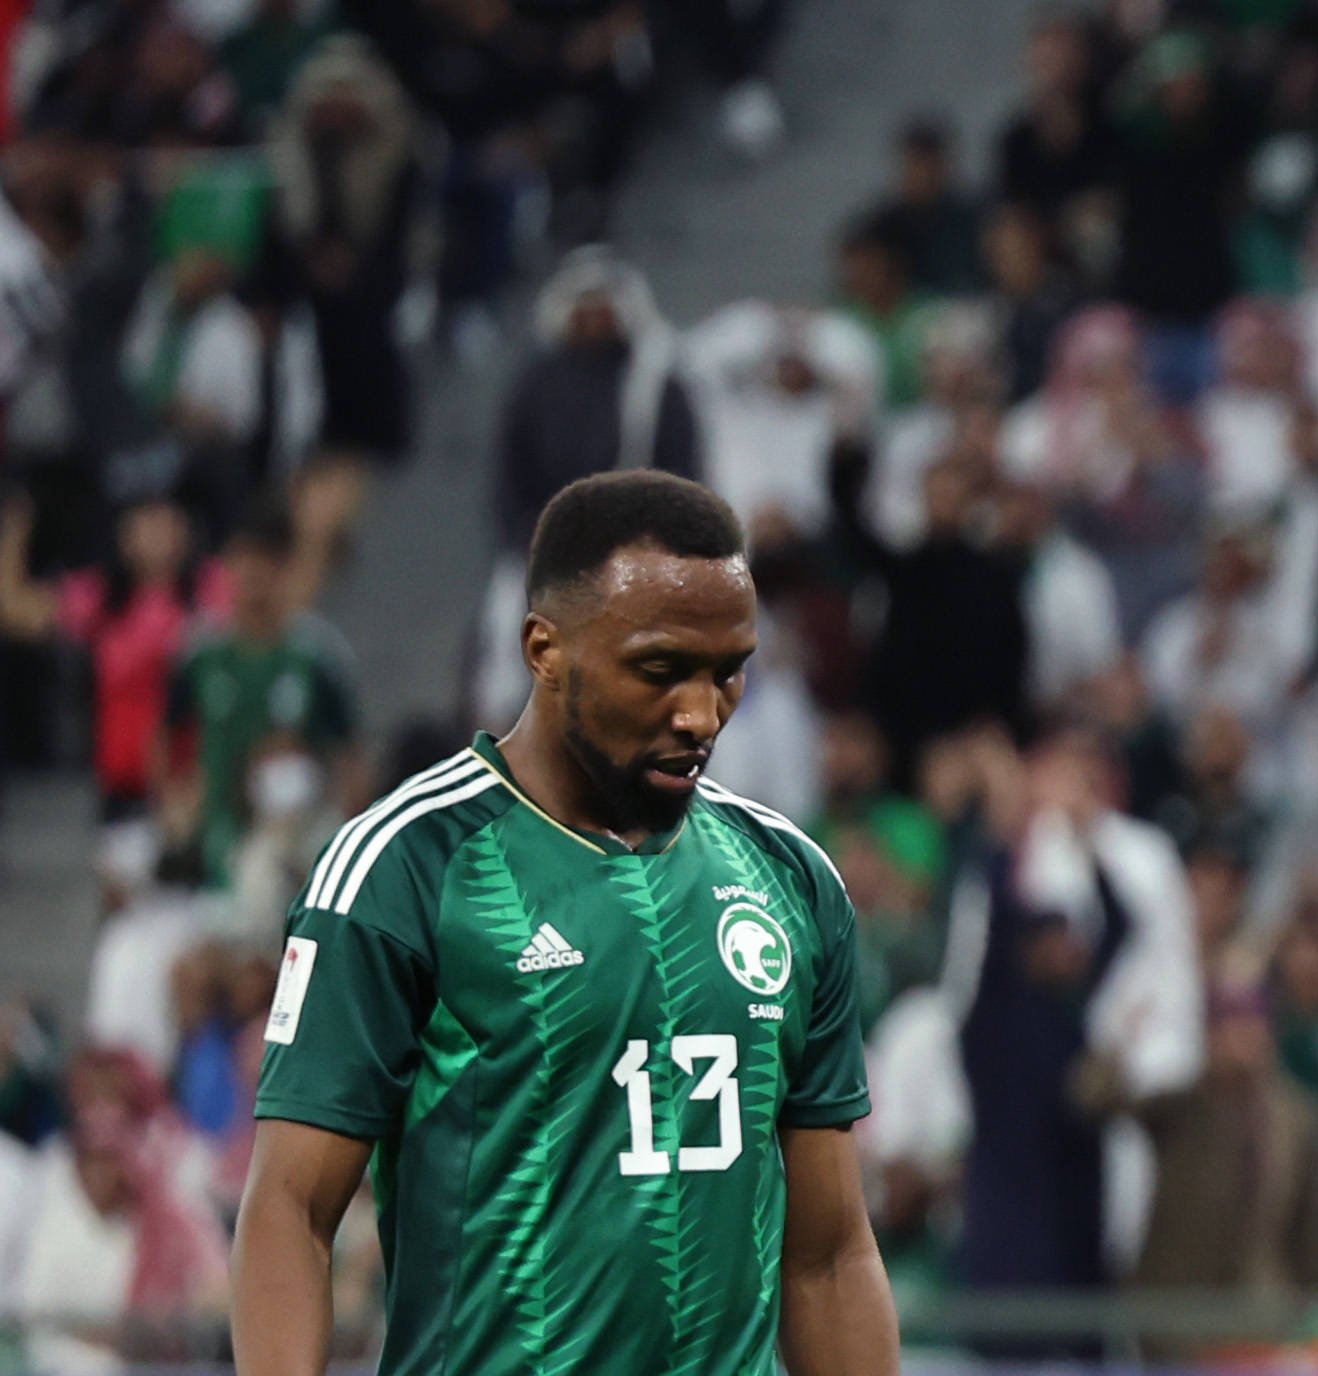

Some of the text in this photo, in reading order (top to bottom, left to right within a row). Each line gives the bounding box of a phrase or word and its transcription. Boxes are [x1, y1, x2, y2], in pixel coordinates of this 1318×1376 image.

[516, 950, 585, 973] adidas
[748, 1003, 785, 1020] SAUDI
[611, 1034, 743, 1176] 13
